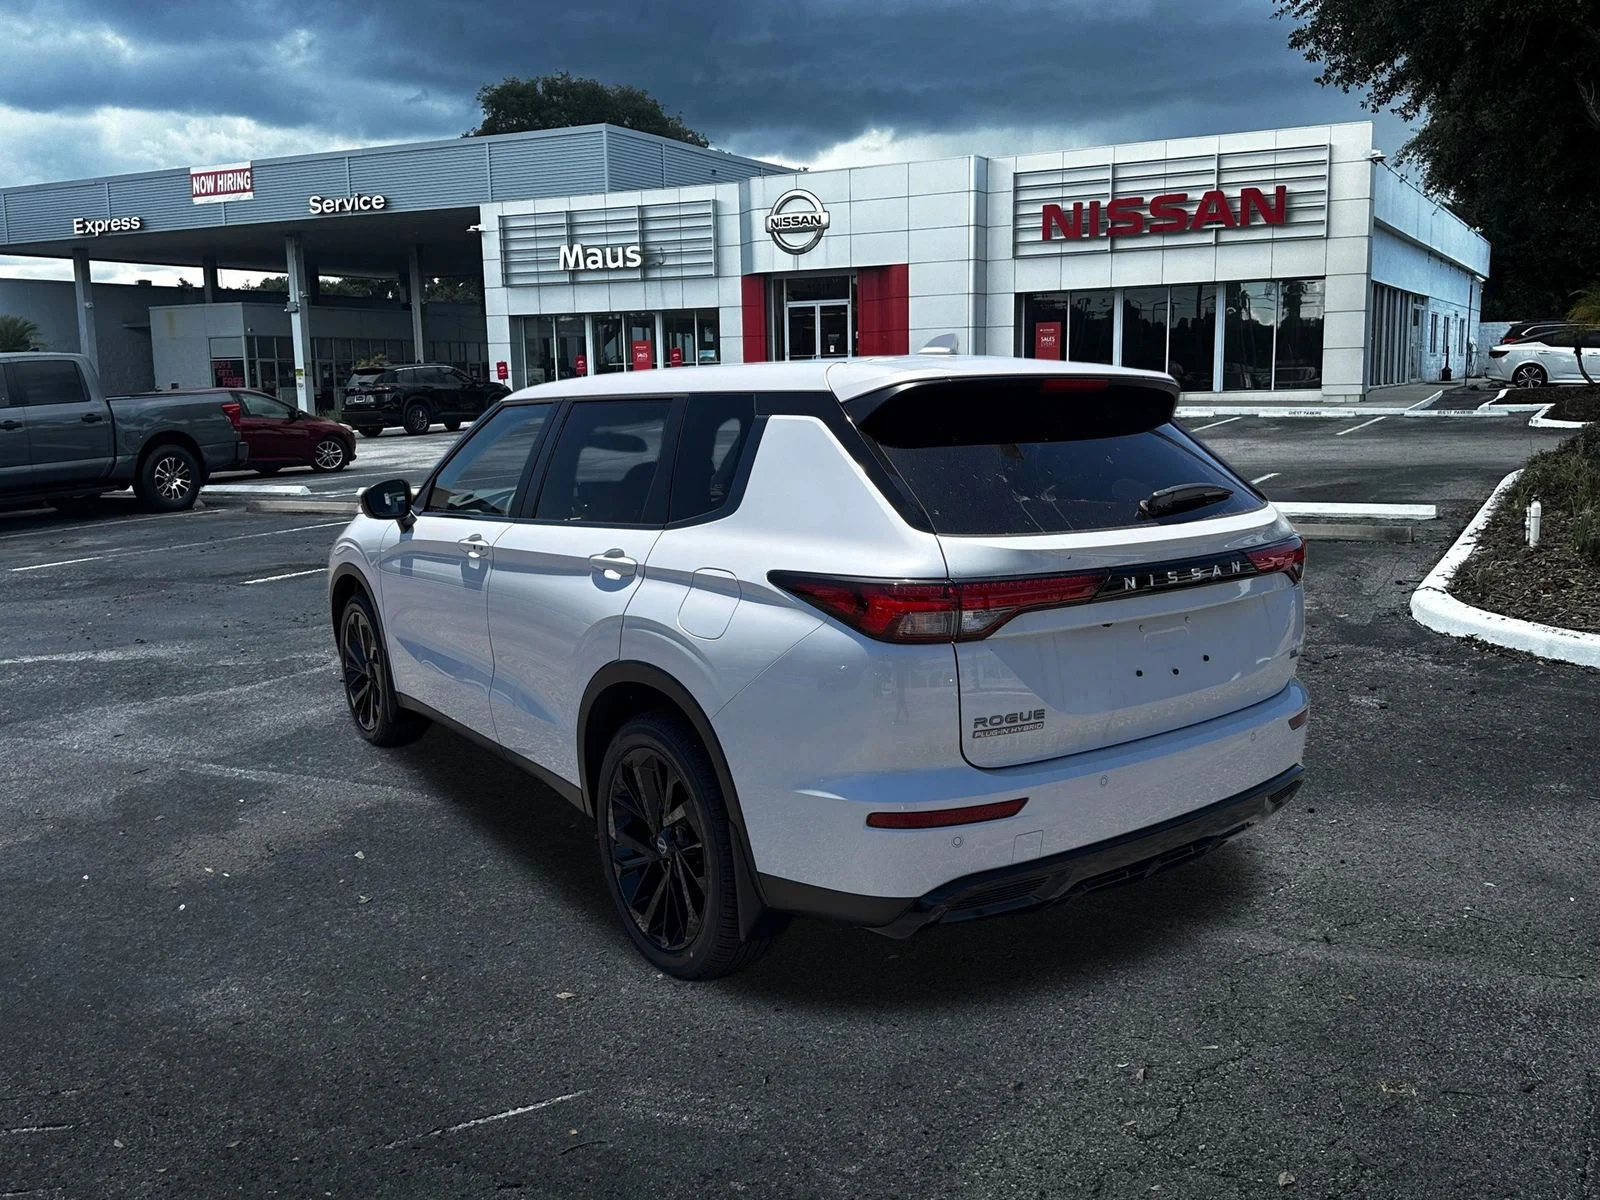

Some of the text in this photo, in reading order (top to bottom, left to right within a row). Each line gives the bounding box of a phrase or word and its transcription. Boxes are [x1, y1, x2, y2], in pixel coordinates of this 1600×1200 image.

[193, 171, 251, 194] NOW HIRING
[309, 193, 385, 214] Service
[1042, 185, 1287, 241] NISSAN
[73, 216, 141, 237] Express
[770, 215, 822, 228] NISSAN
[559, 243, 642, 271] Maus
[222, 377, 244, 387] FREE
[1124, 561, 1240, 590] NISSAN
[974, 709, 1046, 728] ROGUE
[974, 722, 1043, 738] PLUG-IN HYBRID
